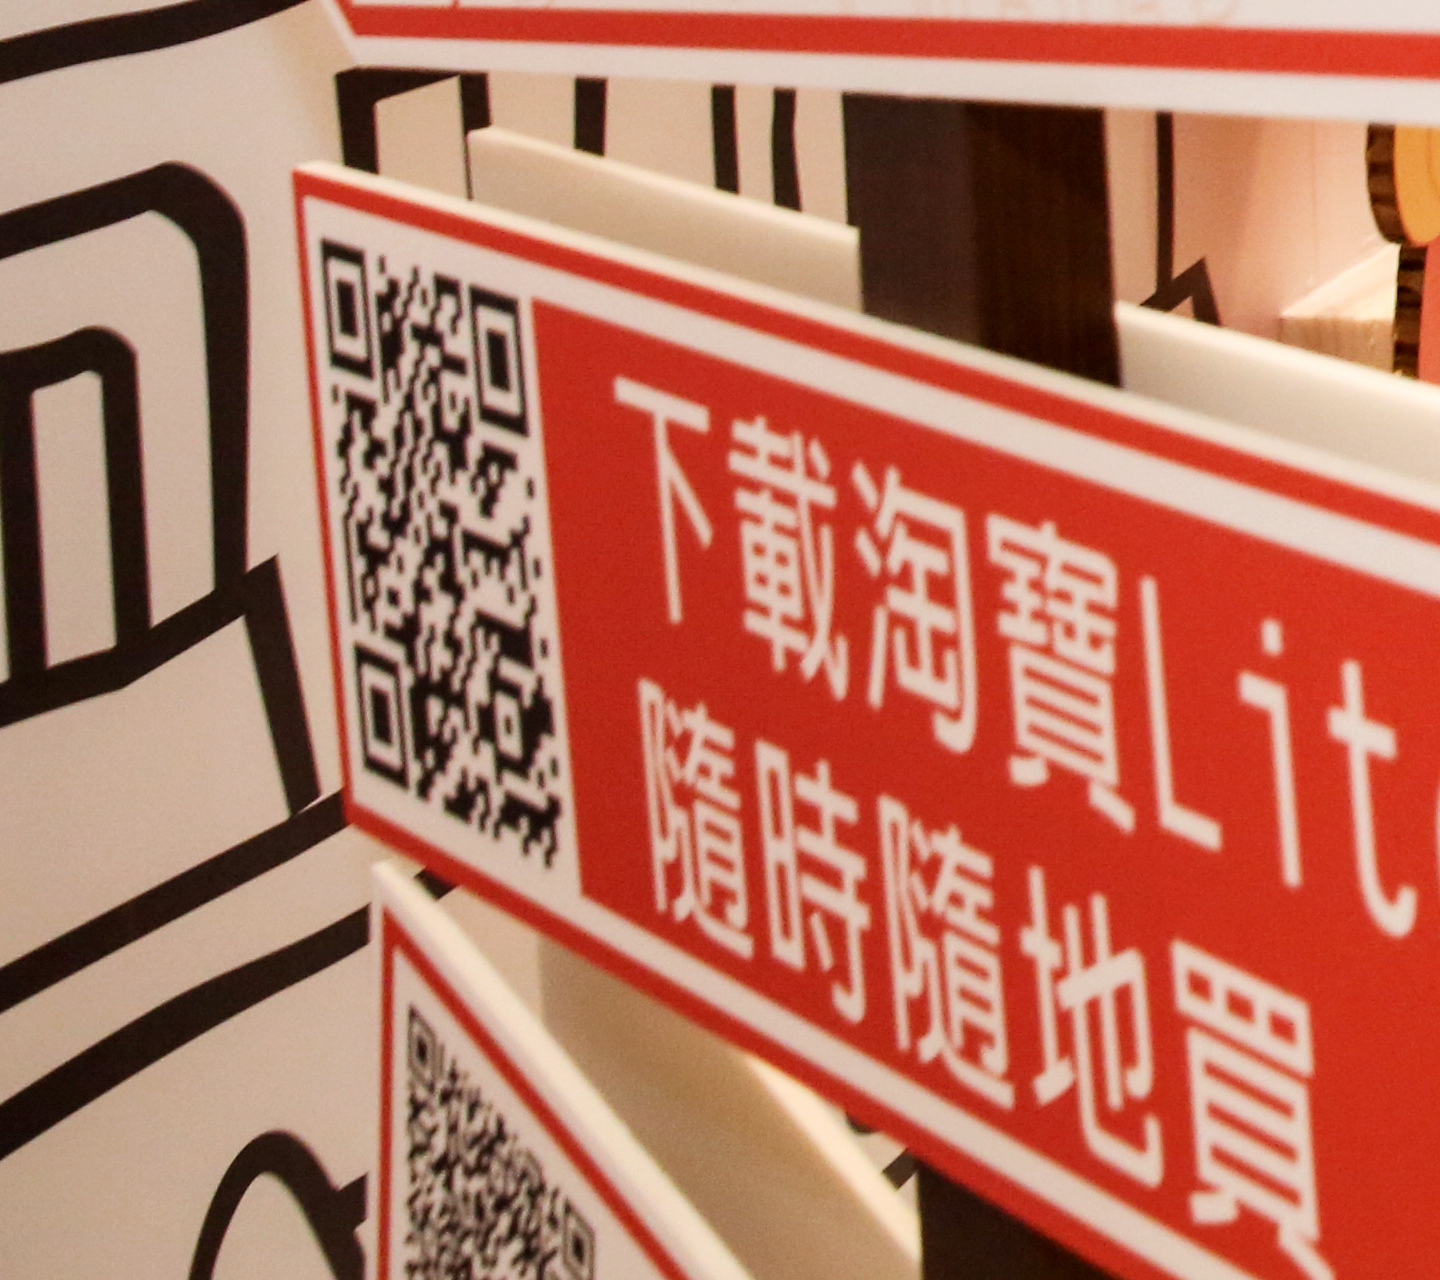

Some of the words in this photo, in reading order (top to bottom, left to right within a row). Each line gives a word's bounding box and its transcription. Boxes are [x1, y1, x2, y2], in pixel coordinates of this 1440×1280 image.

[638, 679, 1336, 1280] 隨時隨地買
